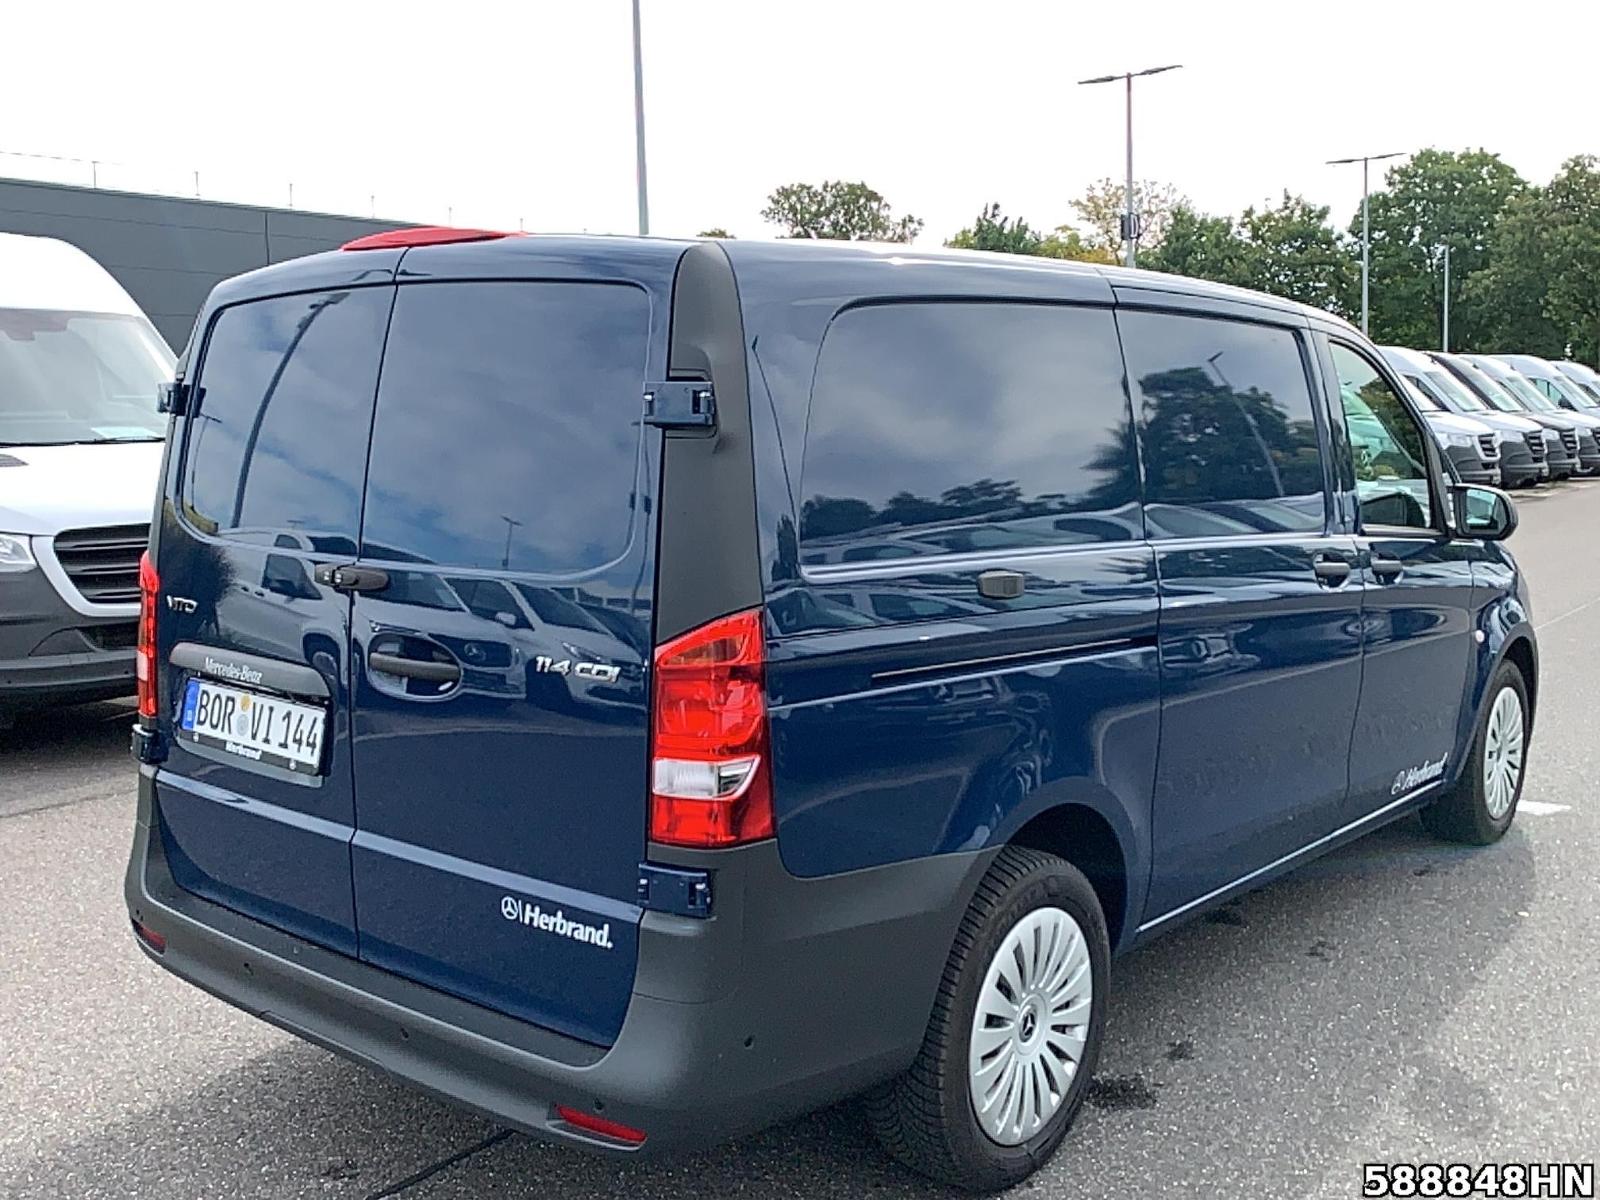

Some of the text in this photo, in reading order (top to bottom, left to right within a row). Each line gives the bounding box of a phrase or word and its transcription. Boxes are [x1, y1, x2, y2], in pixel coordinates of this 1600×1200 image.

[205, 656, 263, 685] Mercedes-Benz
[536, 655, 621, 682] 114 CDI
[196, 689, 318, 757] BOR VI 144
[523, 903, 613, 950] Herbrand.
